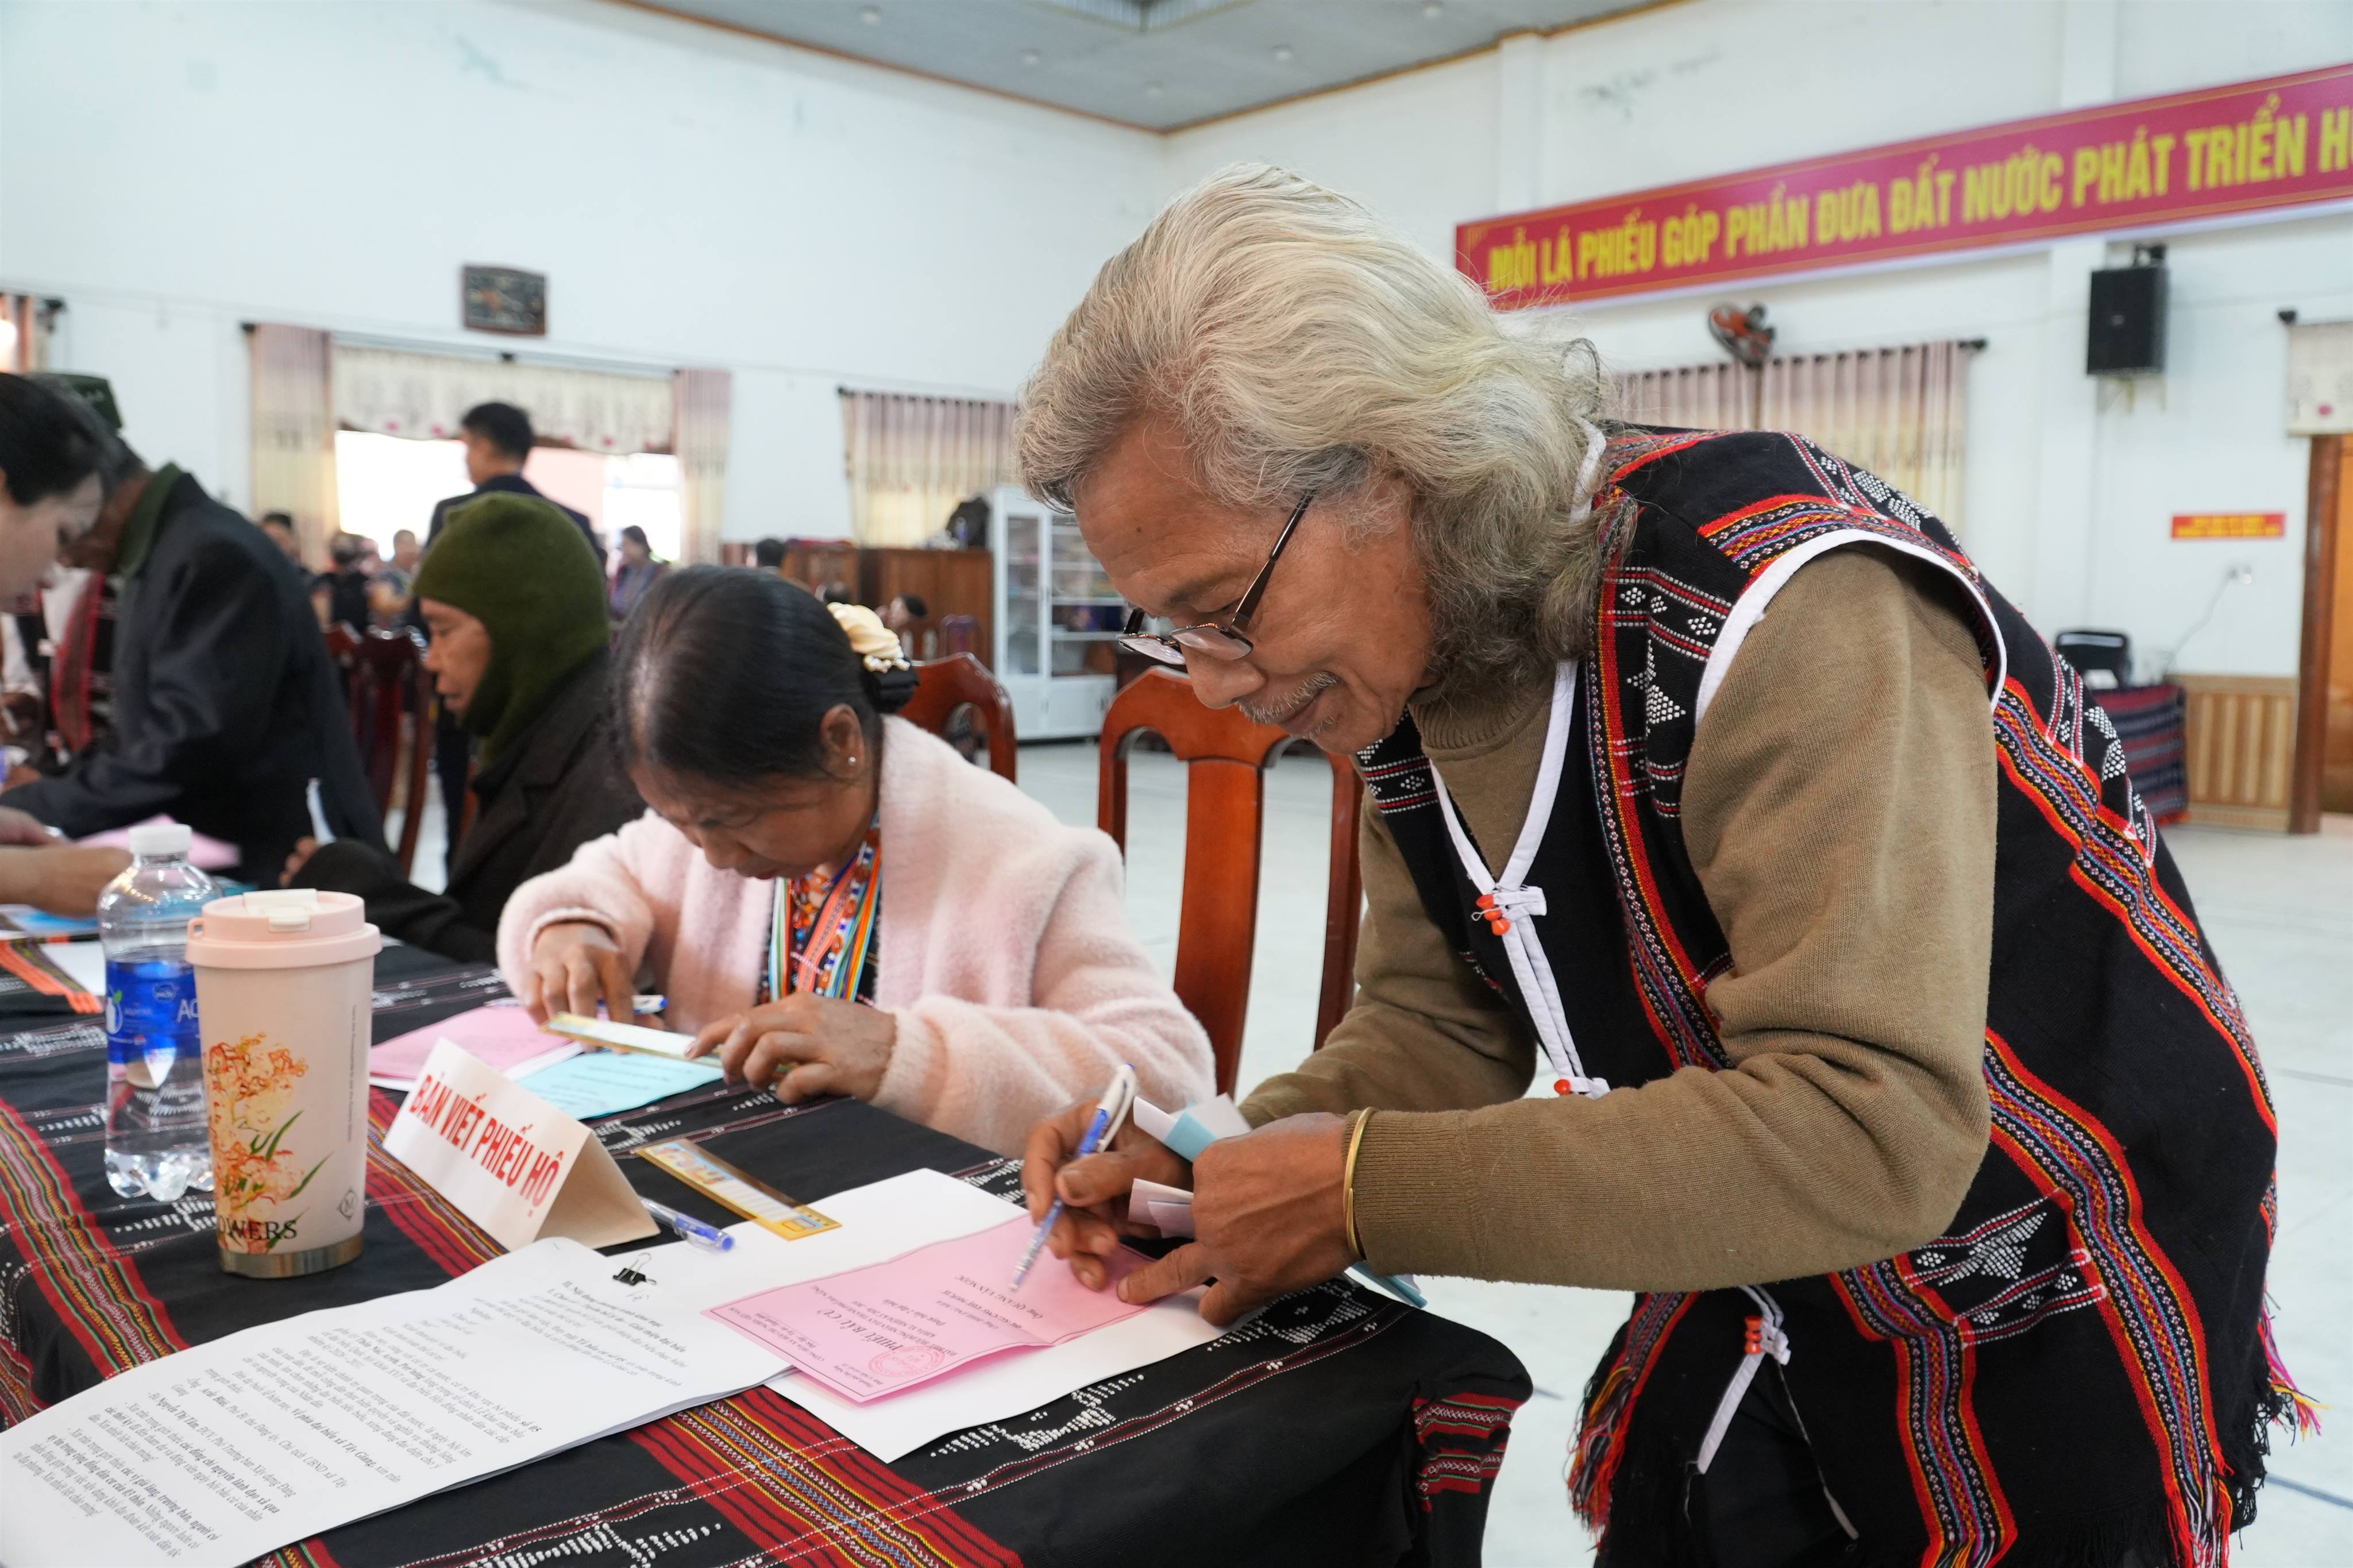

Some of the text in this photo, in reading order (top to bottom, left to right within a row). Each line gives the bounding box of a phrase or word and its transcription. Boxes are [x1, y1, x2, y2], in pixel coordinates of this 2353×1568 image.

[1542, 225, 1573, 284] LÁ
[1578, 207, 1657, 279] PHIẾU
[1662, 202, 1719, 267] GÓP
[1726, 181, 1810, 258] PHẦN
[1816, 180, 1881, 245] ĐƯA
[1888, 152, 1955, 235] ĐẤT
[1962, 144, 2065, 223] NƯỚC
[2072, 124, 2175, 208] PHÁT
[2185, 92, 2309, 191] TRIỂN
[2319, 106, 2353, 172] H
[438, 1093, 486, 1152] VIẾT
[470, 1124, 535, 1188] PHIẾU
[520, 1151, 565, 1218] HỘ
[861, 1332, 902, 1350] PHIẾU
